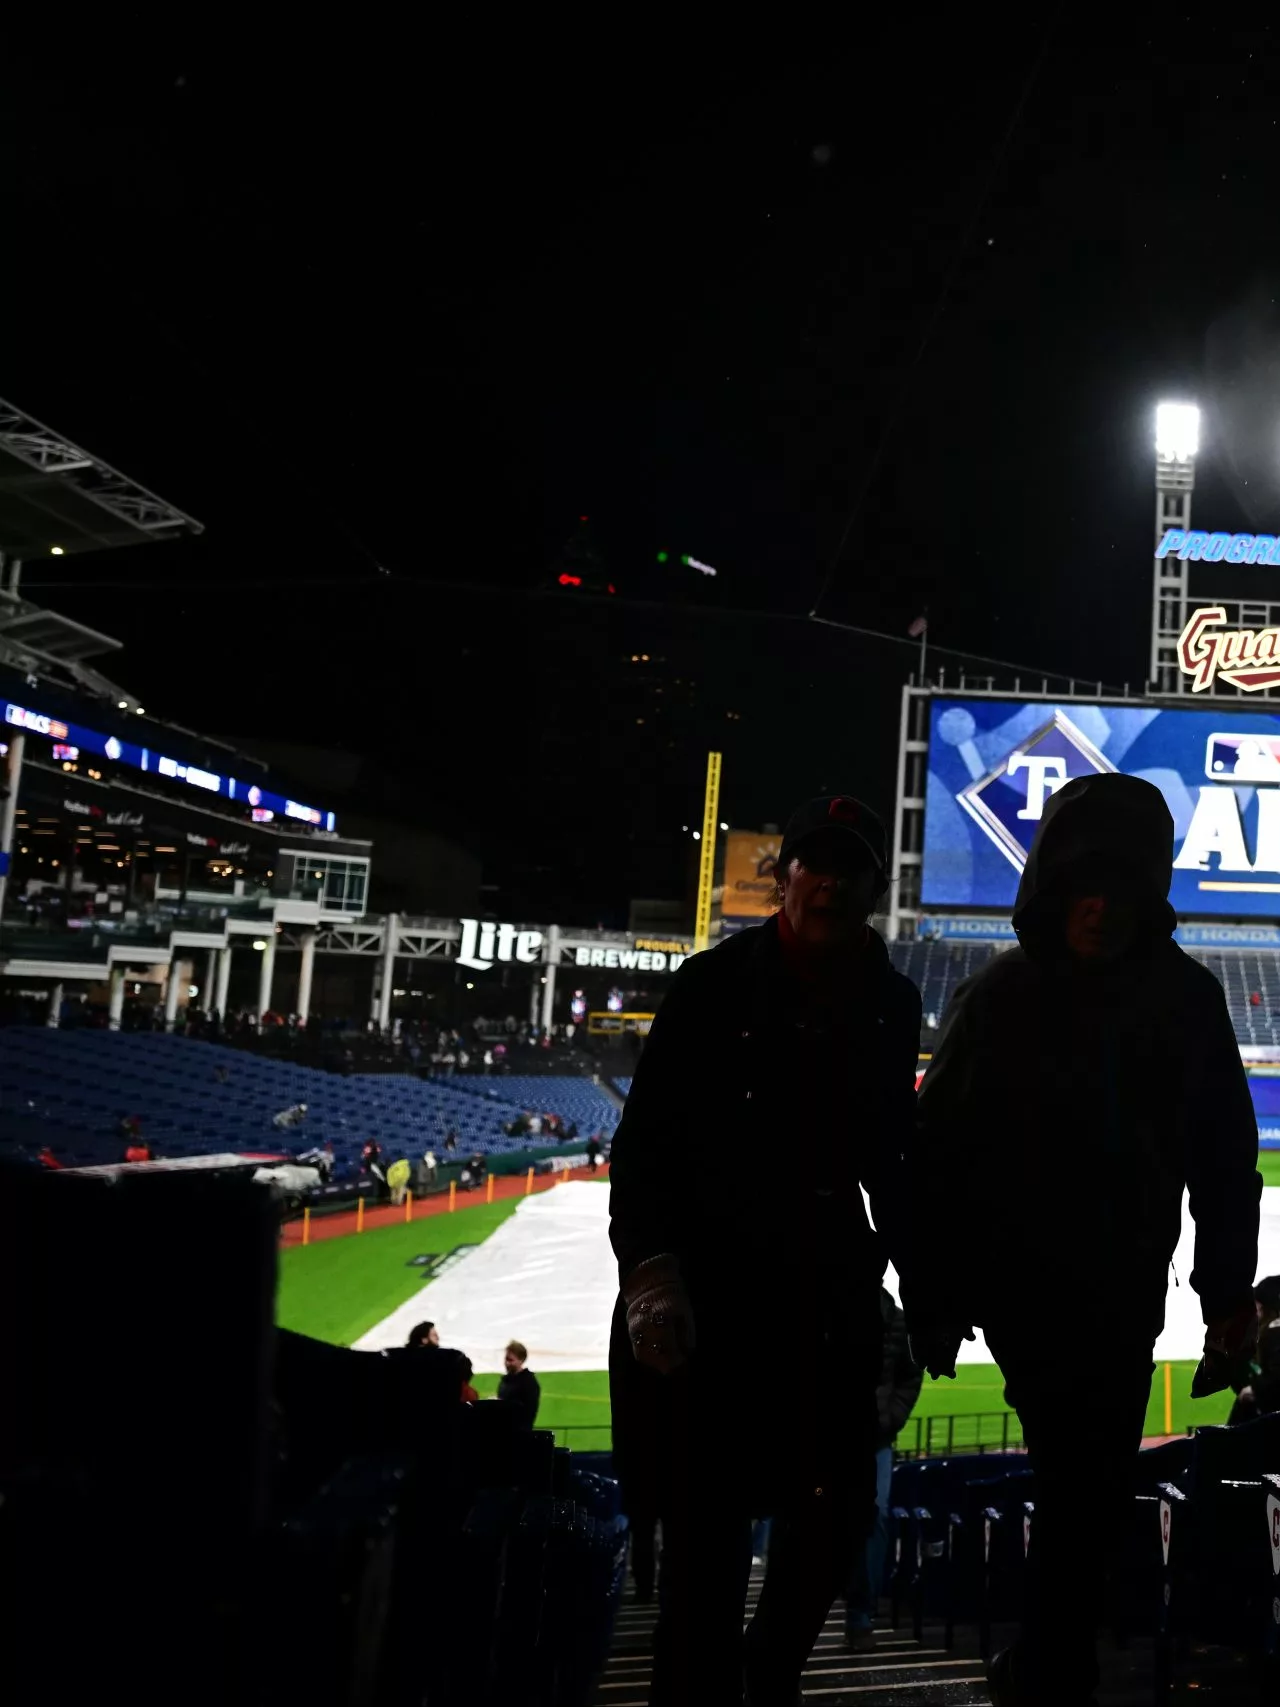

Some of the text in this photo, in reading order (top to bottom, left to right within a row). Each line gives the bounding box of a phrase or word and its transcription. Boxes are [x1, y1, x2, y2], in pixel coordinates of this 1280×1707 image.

[949, 920, 1015, 934] HOND
[1203, 928, 1280, 944] HONDA
[456, 918, 544, 970] Lite
[575, 946, 667, 971] BREWED
